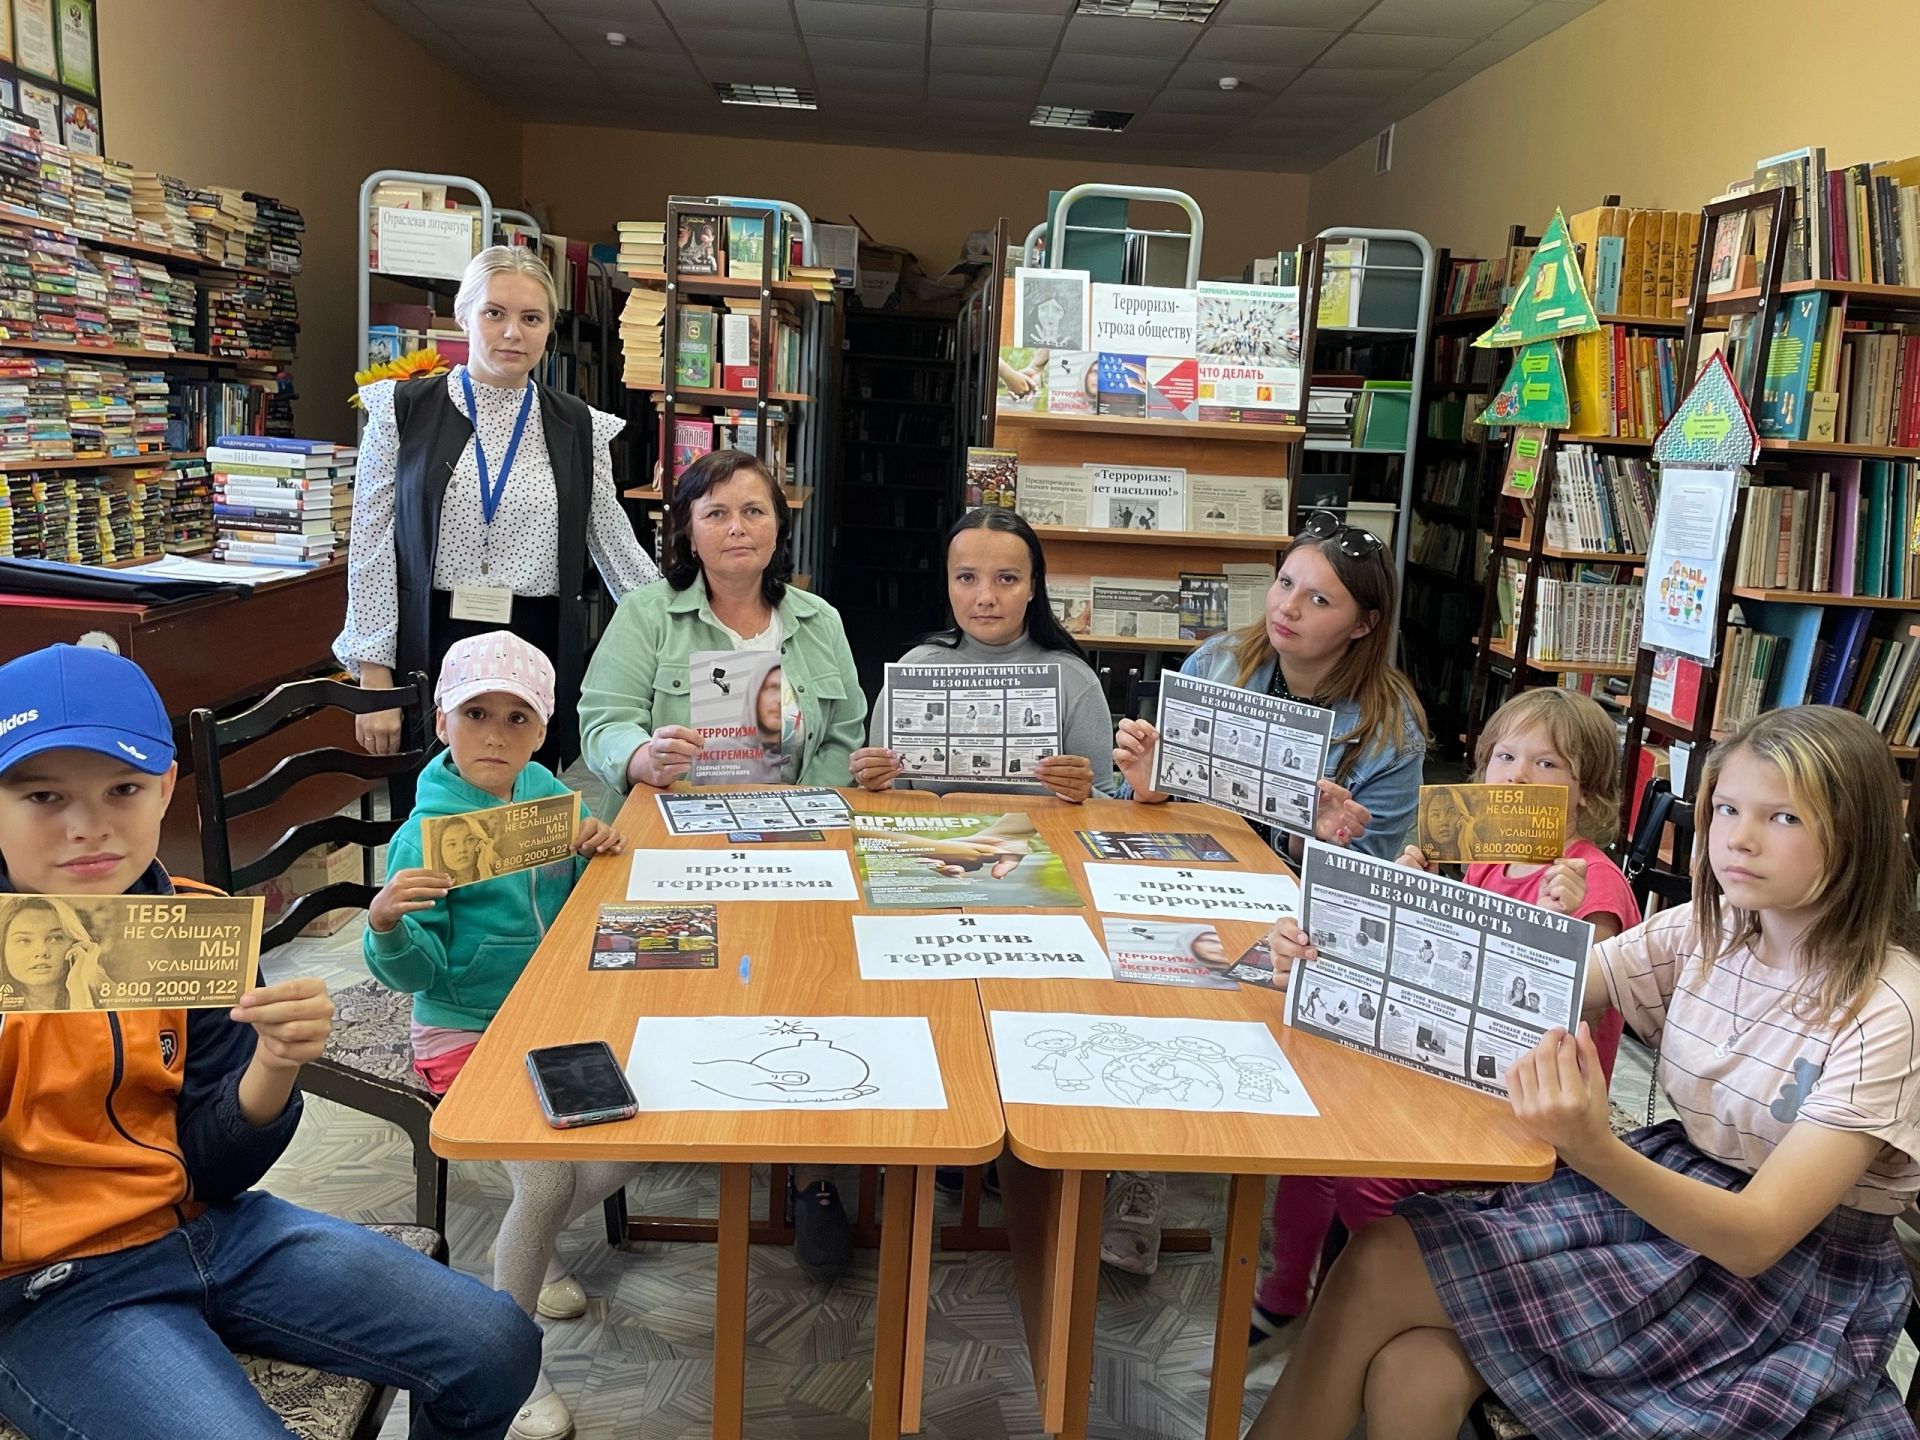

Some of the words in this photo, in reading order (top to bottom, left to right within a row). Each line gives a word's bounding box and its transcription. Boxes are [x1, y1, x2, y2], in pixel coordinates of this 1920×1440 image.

[1113, 291, 1180, 316] Терроризм-
[1098, 321, 1135, 340] угроза
[1138, 320, 1194, 345] обществу
[1199, 367, 1220, 380] ЧТО
[1221, 367, 1265, 381] ДЕЛАТЬ
[676, 427, 710, 449] ЛЯКОВА
[1094, 468, 1171, 484] «Терроризм:
[1114, 483, 1179, 498] насилию!»
[900, 664, 1050, 677] АНТИТЕРРОРИСТИЧЕСКАЯ
[932, 677, 1022, 688] БЕЗОПАСНОСТЬ
[1173, 677, 1321, 719] АНТИТЕРРОРИСТИЧЕСКАЯ
[1200, 694, 1287, 723] БЕЗОПАСНОСТЬ
[696, 726, 758, 739] ТЕРРОРИЗМ
[696, 749, 764, 761] ЭКСТРЕМИЗМ
[1488, 790, 1524, 804] ТЕБЯ
[505, 805, 539, 823] ТЕБЯ
[1486, 806, 1499, 815] НЕ
[1501, 804, 1560, 817] СЛЫШАТ?
[504, 823, 518, 833] НЕ
[519, 812, 568, 830] СЛЫШАТ?
[546, 820, 568, 835] МЫ
[854, 815, 981, 828] ПРИМЕР
[1531, 816, 1560, 829] МЫ
[518, 831, 568, 849] УСЛЫШИМ!
[1500, 827, 1559, 840] УСЛЫШИМ!
[495, 859, 501, 870] 8
[503, 854, 523, 868] 800
[524, 848, 549, 863] 2000
[550, 843, 568, 856] 122
[730, 852, 746, 860] Я
[1475, 842, 1481, 853] 8
[1483, 842, 1502, 854] 800
[1504, 842, 1533, 855] 2000
[1536, 845, 1558, 857] 122
[685, 865, 793, 876] против
[1176, 871, 1194, 879] Я
[652, 877, 835, 891] терроризма
[1139, 880, 1246, 896] против
[1324, 852, 1571, 935] АНТИТЕРРОРИСТИЧЕСКАЯ
[1114, 892, 1295, 913] терроризма
[1369, 882, 1514, 936] БЕЗОПАСНОСТЬ
[126, 904, 187, 924] ТЕБЯ
[958, 917, 977, 927] Я
[123, 926, 146, 940] НЕ
[150, 925, 241, 940] СЛЫШАТ?
[914, 932, 1034, 947] против
[199, 940, 240, 957] МЫ
[883, 949, 1086, 967] терроризма
[1117, 952, 1197, 964] ТЕРРОРИЗМ
[147, 959, 239, 973] УСЛЫШИМ!
[1119, 964, 1211, 976] ЭКСТРЕМИЗМ
[100, 982, 111, 998] 8
[116, 981, 151, 997] 800
[155, 980, 201, 996] 2000
[206, 979, 238, 995] 122
[157, 995, 196, 1003] БЕСПЛАТНО
[1521, 1037, 1540, 1047] УСТРО
